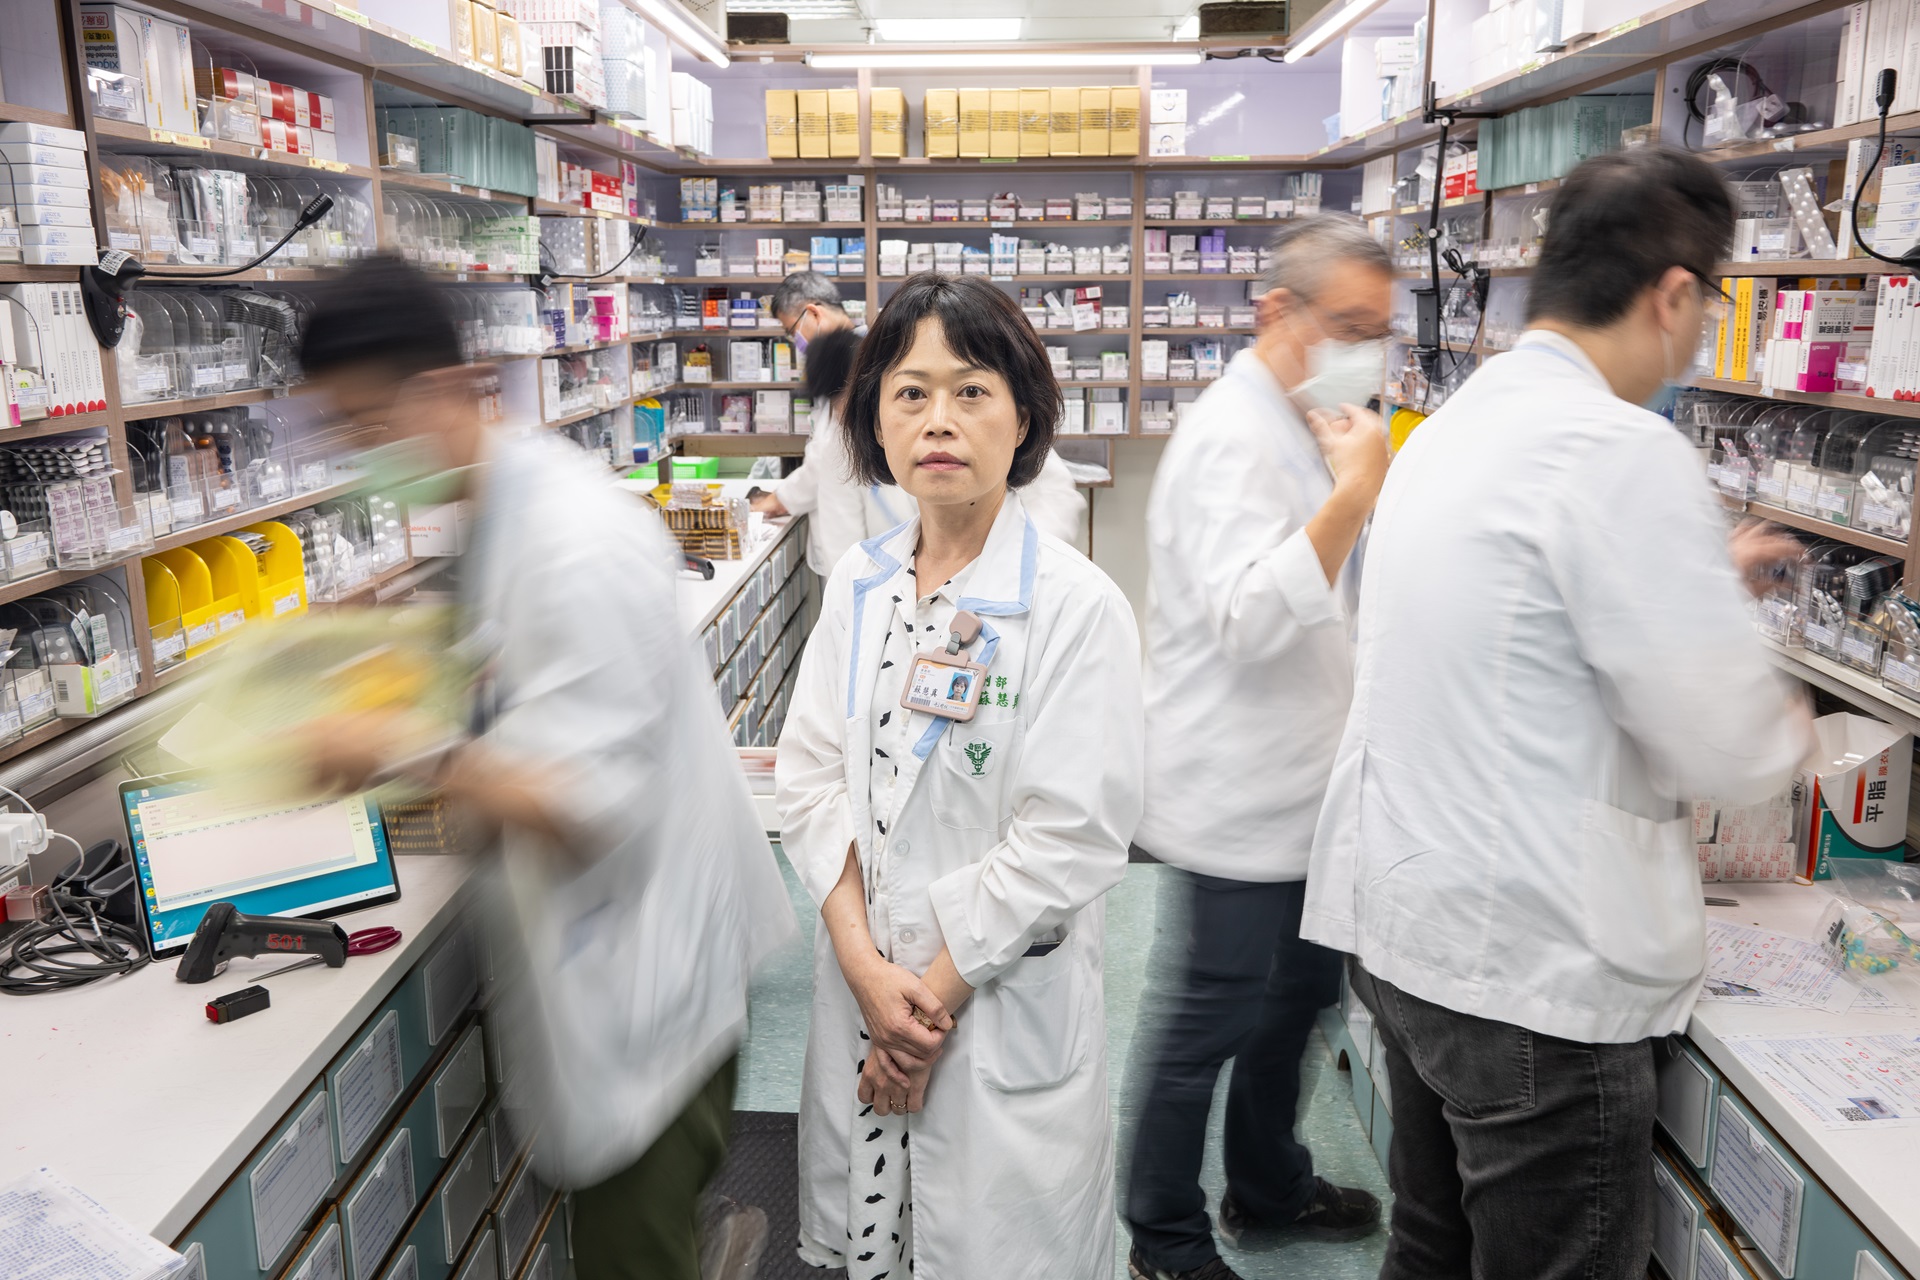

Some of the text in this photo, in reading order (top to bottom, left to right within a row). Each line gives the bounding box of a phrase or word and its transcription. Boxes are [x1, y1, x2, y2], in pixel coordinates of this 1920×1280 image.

[1895, 143, 1903, 166] CRES
[1864, 779, 1887, 823] 平脂
[265, 933, 303, 950] 501
